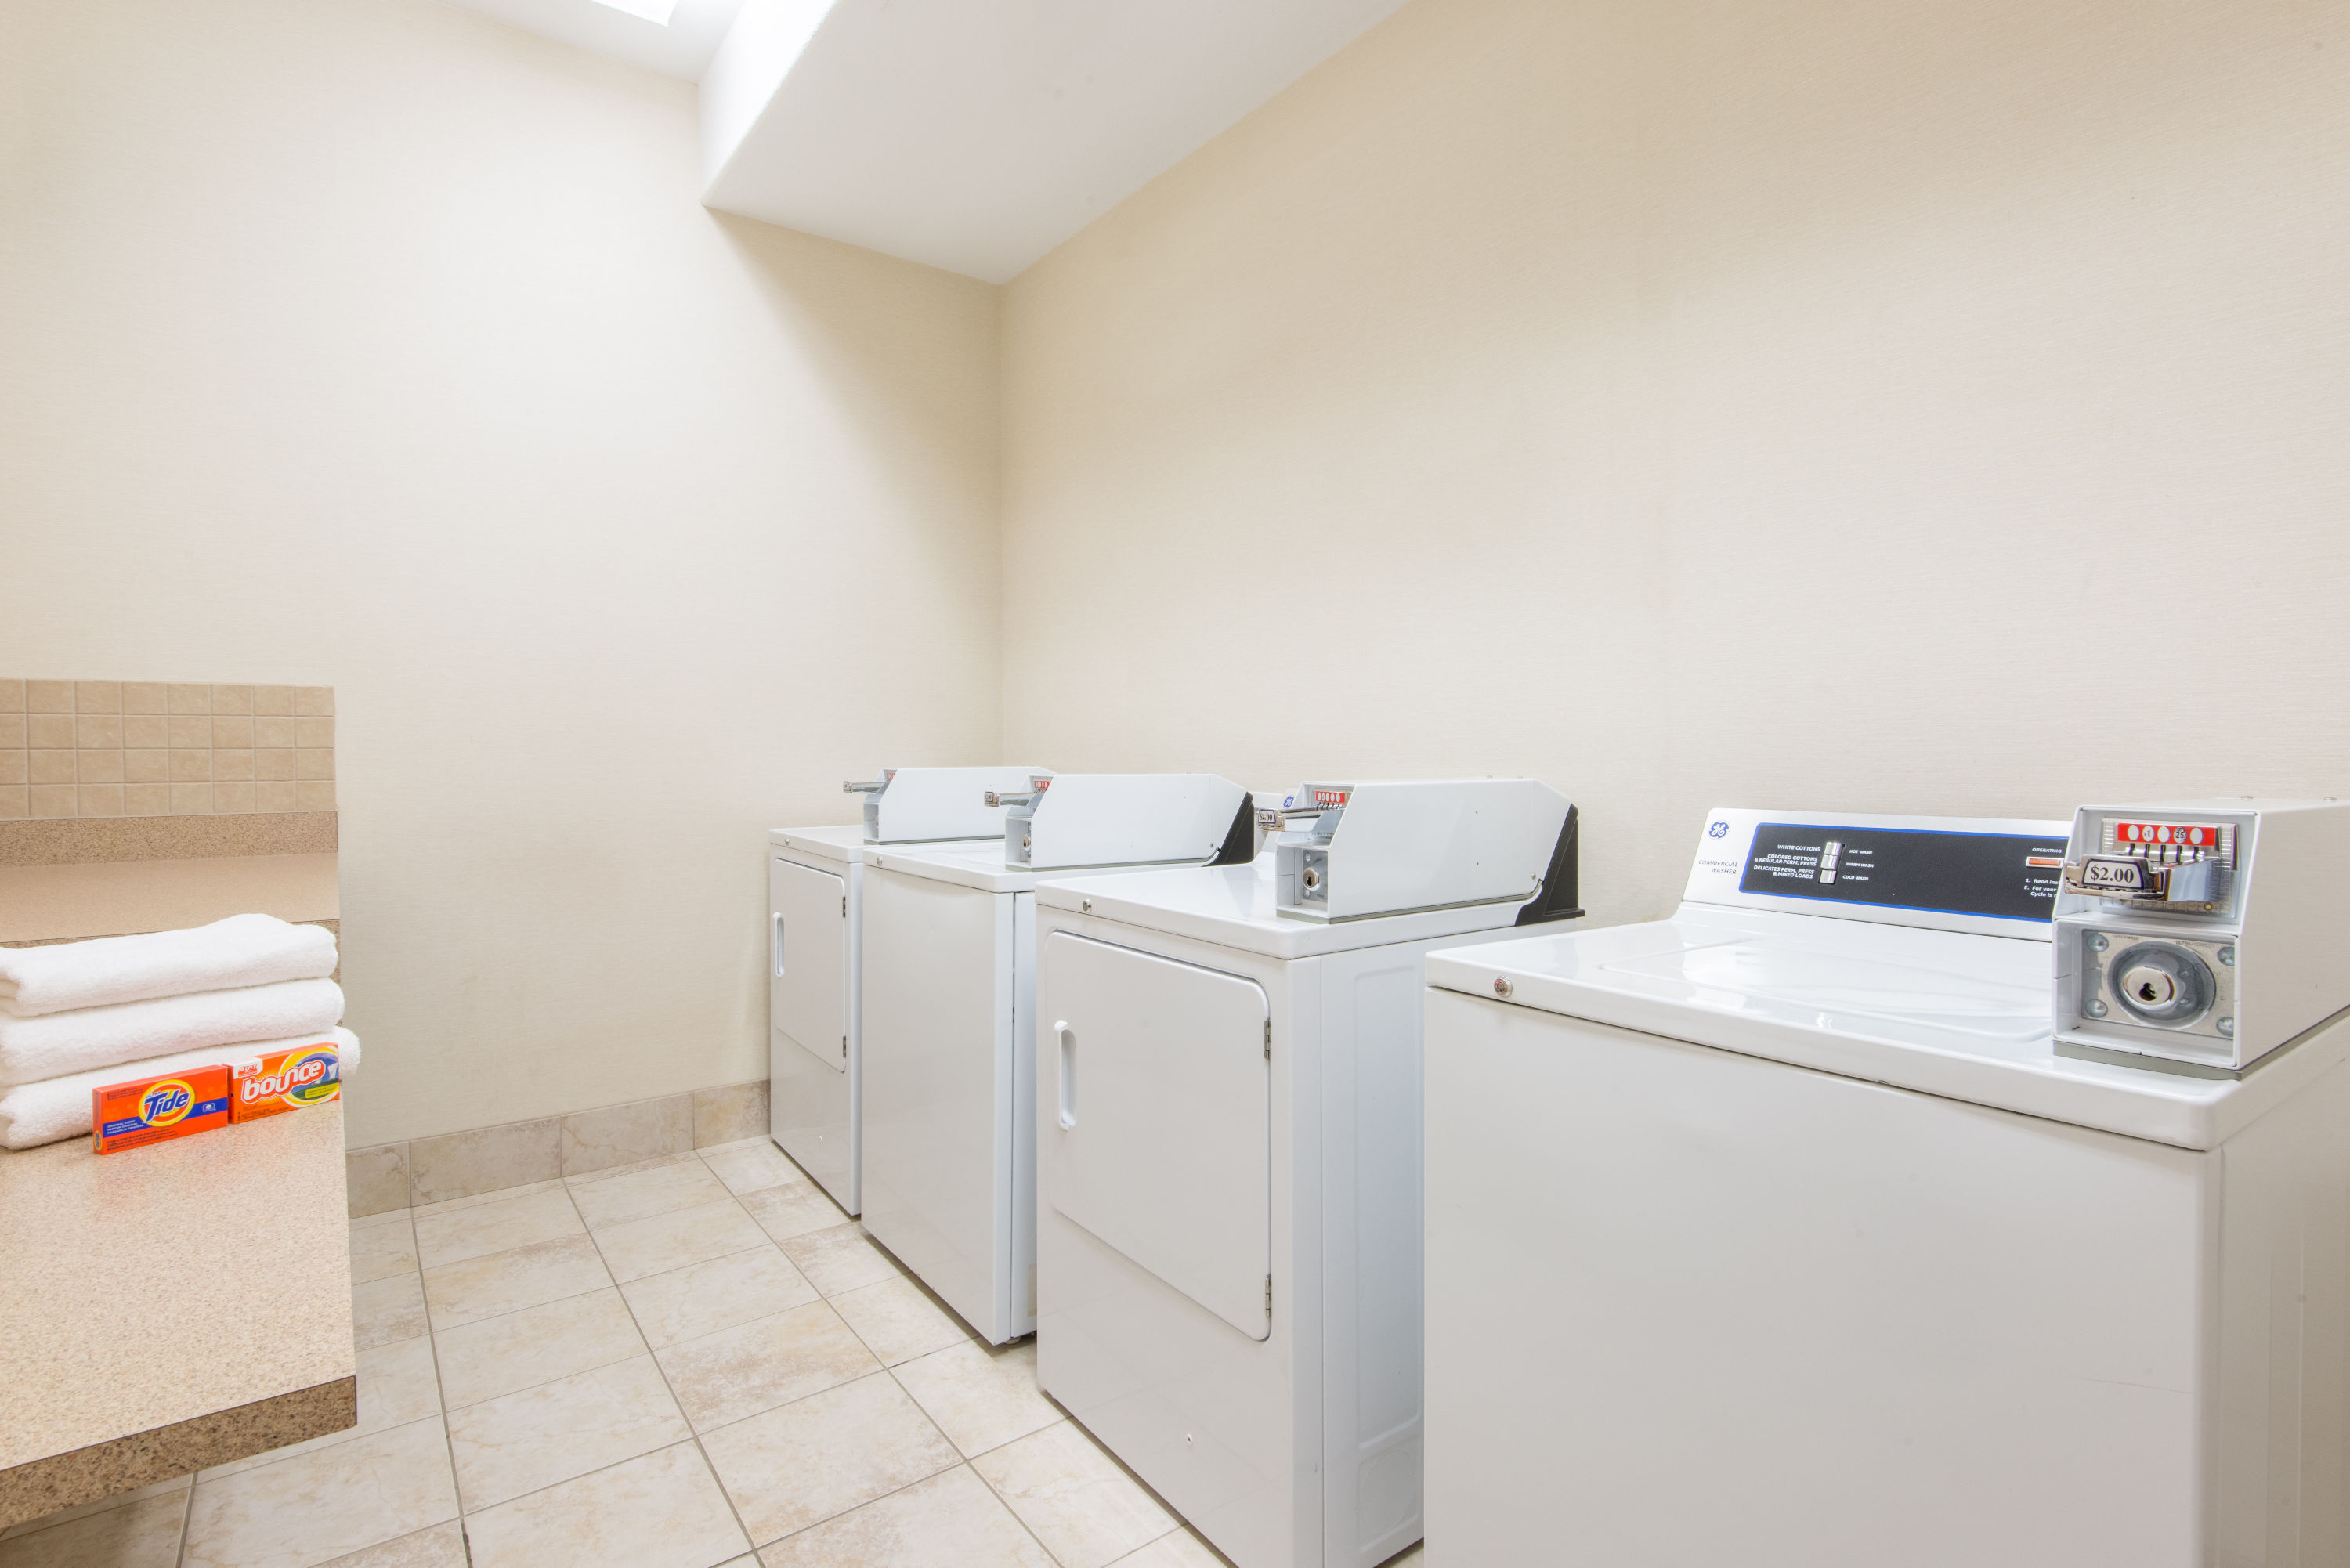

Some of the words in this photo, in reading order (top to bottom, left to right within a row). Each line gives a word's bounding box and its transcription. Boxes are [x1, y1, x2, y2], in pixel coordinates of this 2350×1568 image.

[2090, 865, 2134, 883] $2.00
[243, 1060, 322, 1101] bounce
[143, 1089, 190, 1123] Tide
